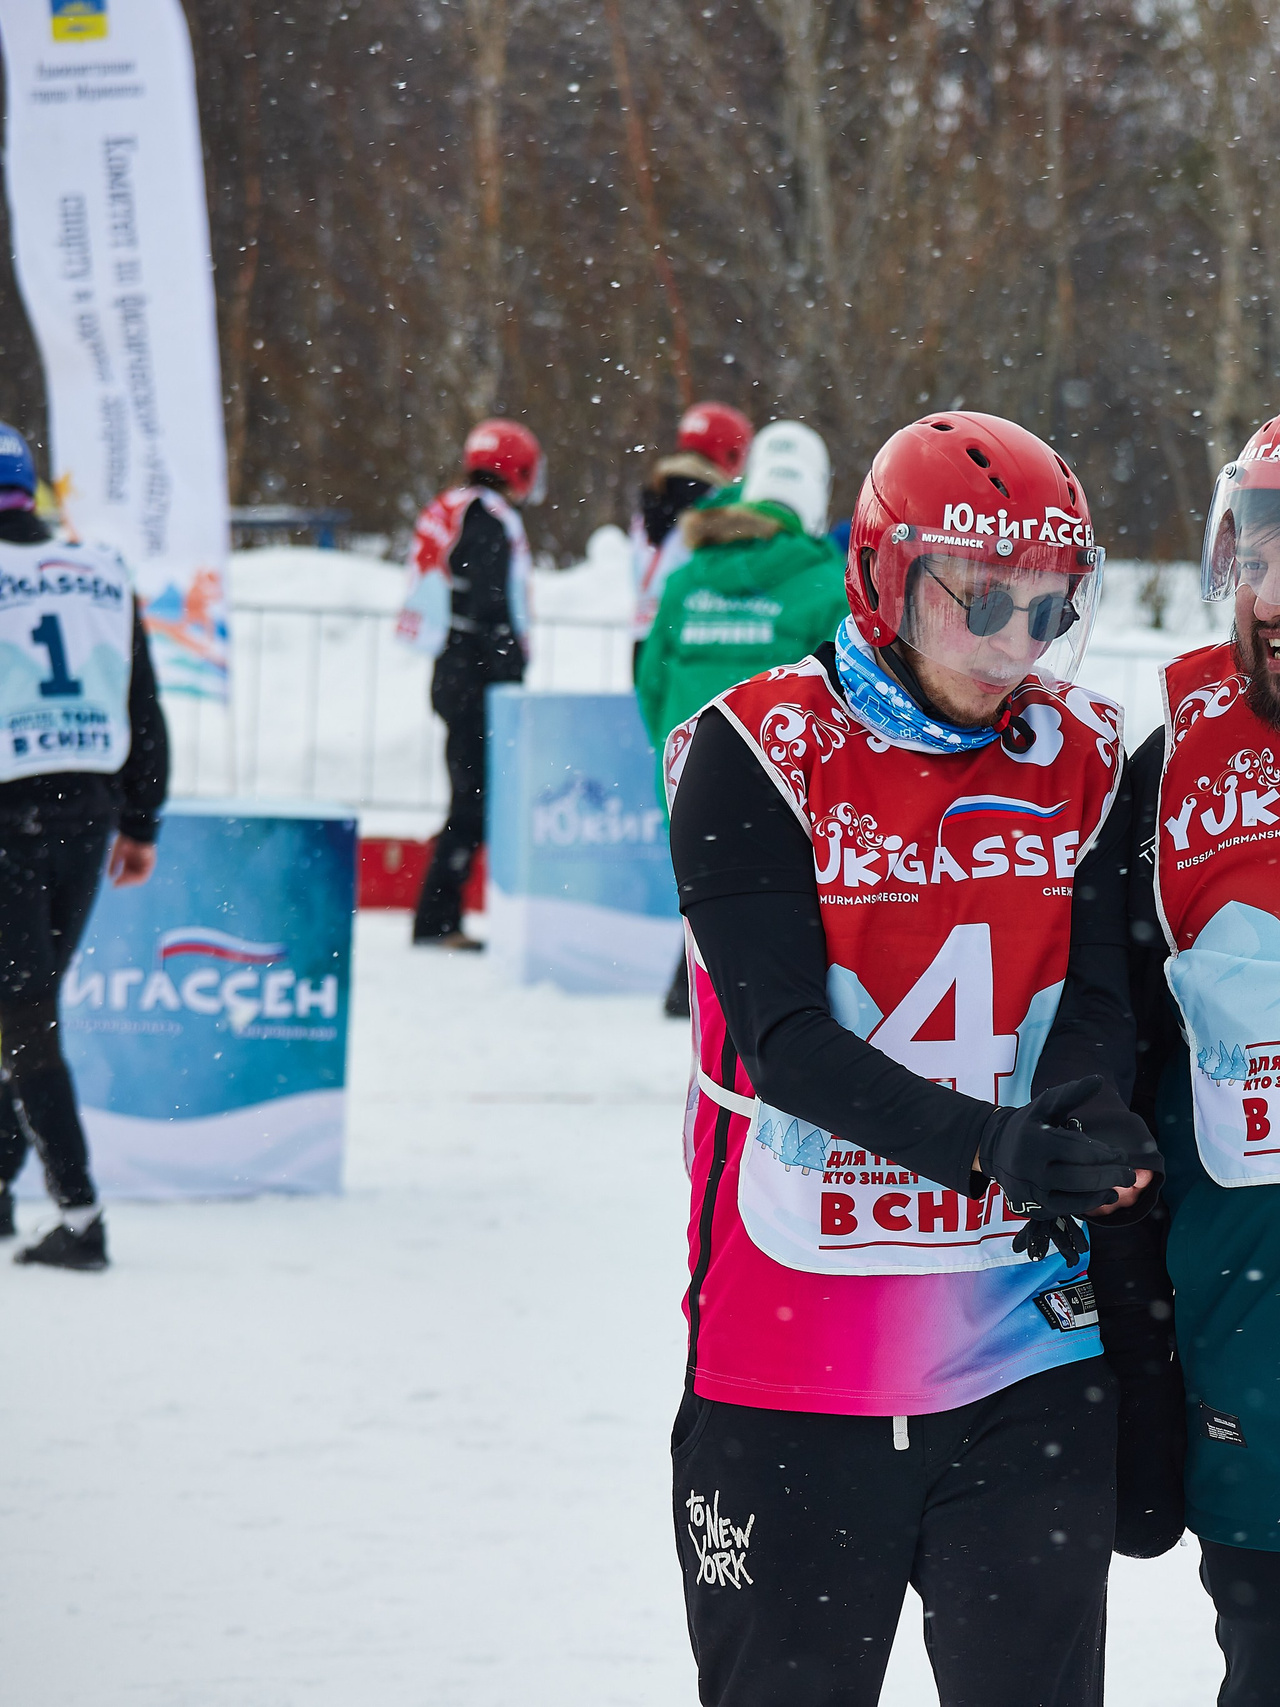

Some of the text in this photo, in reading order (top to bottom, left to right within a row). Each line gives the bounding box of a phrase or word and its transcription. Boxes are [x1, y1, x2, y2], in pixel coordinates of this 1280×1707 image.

[921, 533, 984, 549] МУРМАНСК
[31, 613, 83, 697] 1
[1176, 849, 1216, 870] RUSSIA,
[820, 892, 919, 906] MURMANS REGION
[866, 922, 1020, 1106] 4
[1243, 1076, 1271, 1091] КТО
[1242, 1097, 1271, 1141] В
[826, 1150, 866, 1168] ДЛЯ
[822, 1171, 920, 1185] КТО ЗНАЕТ
[821, 1191, 858, 1235] В
